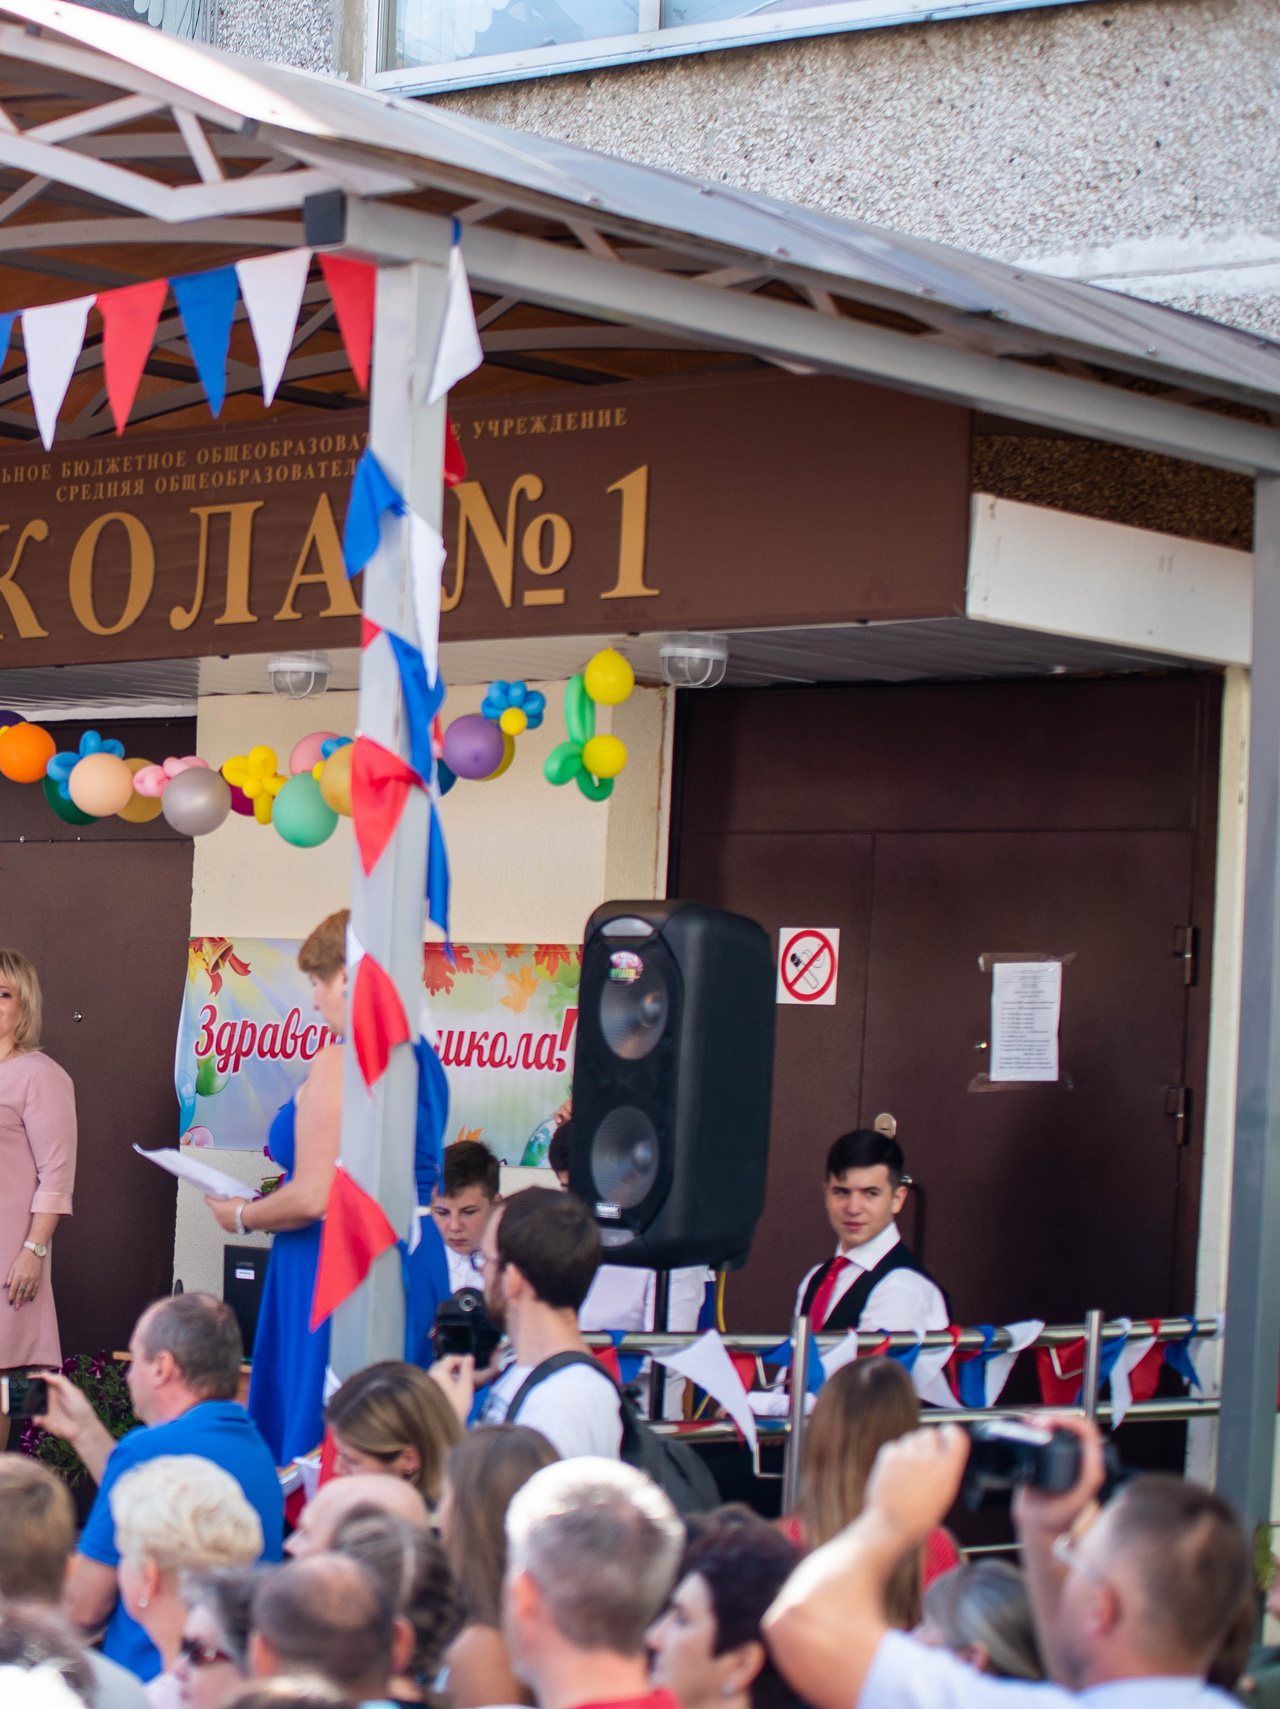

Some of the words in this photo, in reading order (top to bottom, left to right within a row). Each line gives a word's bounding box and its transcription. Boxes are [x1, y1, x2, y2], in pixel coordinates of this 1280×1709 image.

[61, 449, 187, 479] БЮДЖЕТНОЕ
[472, 406, 628, 439] УЧРЕЖДЕНИЕ
[55, 476, 145, 503] СРЕДНЯЯ
[154, 457, 355, 495] ОБЩЕОБРАЗОВАТЕЛ
[440, 472, 572, 613] №
[600, 464, 661, 600] 1
